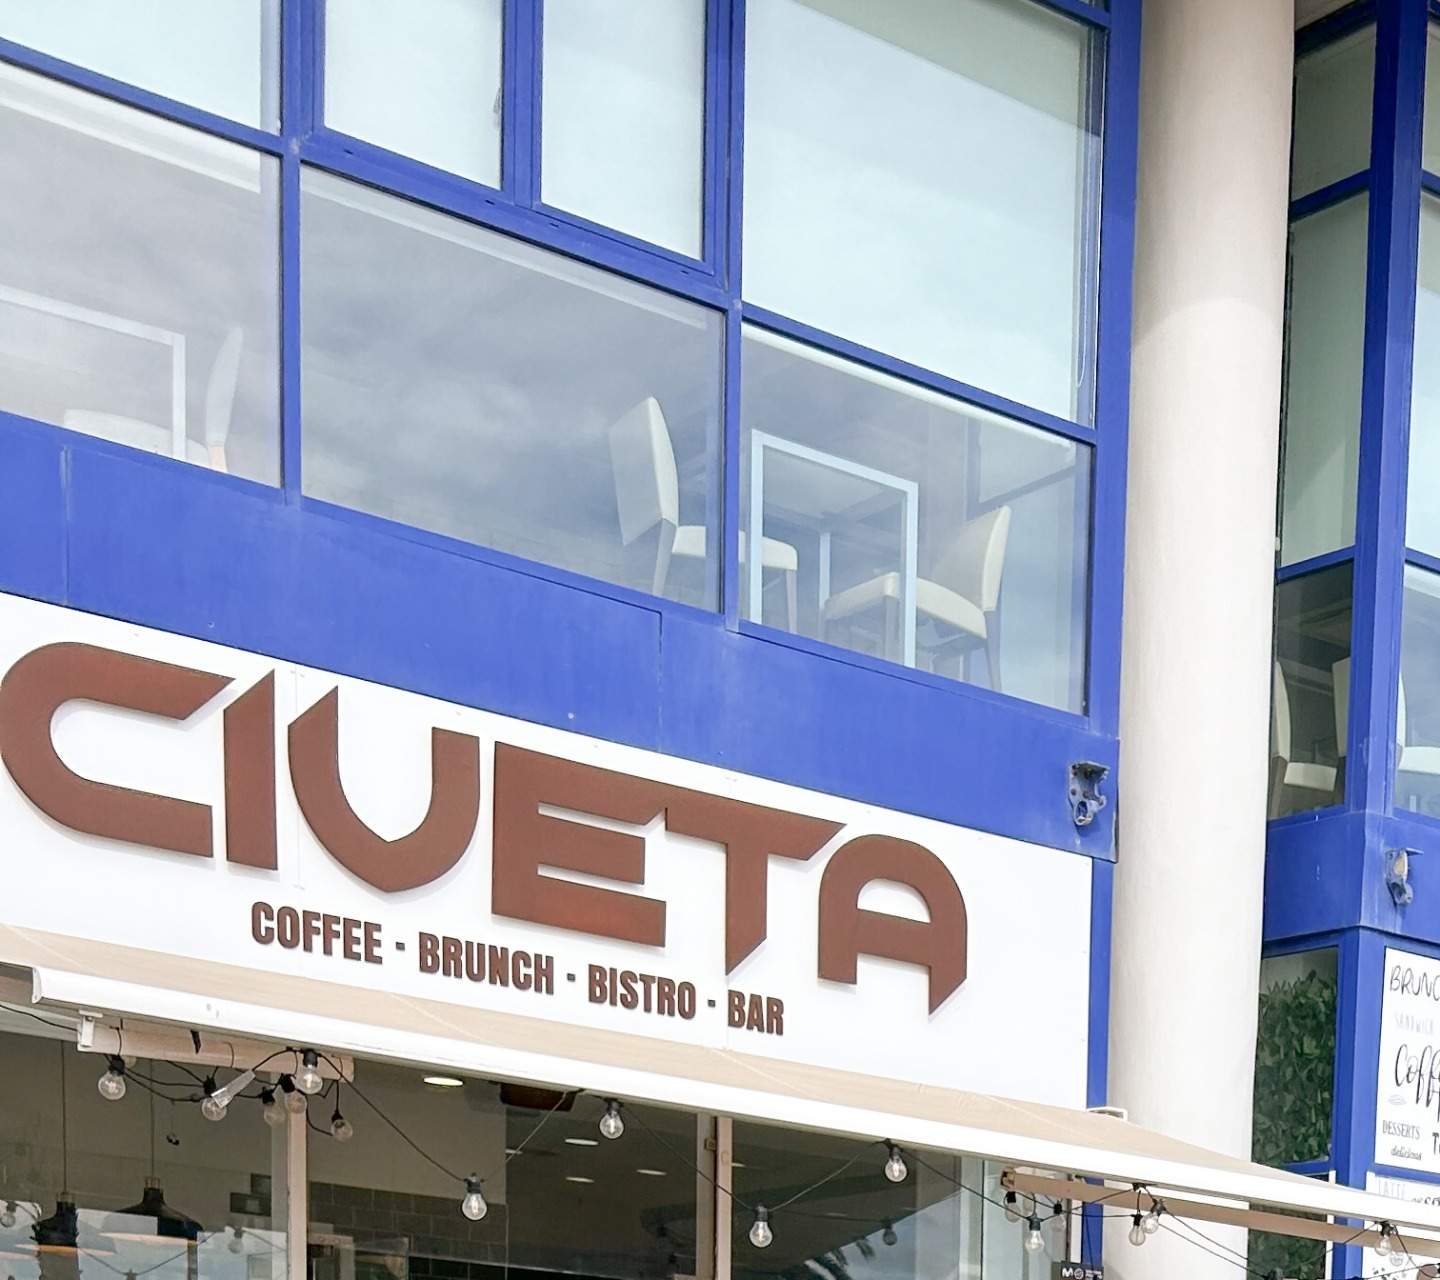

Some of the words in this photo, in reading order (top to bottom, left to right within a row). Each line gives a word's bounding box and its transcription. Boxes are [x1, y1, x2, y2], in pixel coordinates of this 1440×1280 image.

[0, 641, 967, 1015] CIVETA
[251, 901, 383, 965] COFFEE
[417, 931, 554, 995] BRUNCH
[587, 967, 696, 1021] BISTRO
[727, 989, 785, 1036] BAR
[1382, 1120, 1420, 1140] DESSERTS
